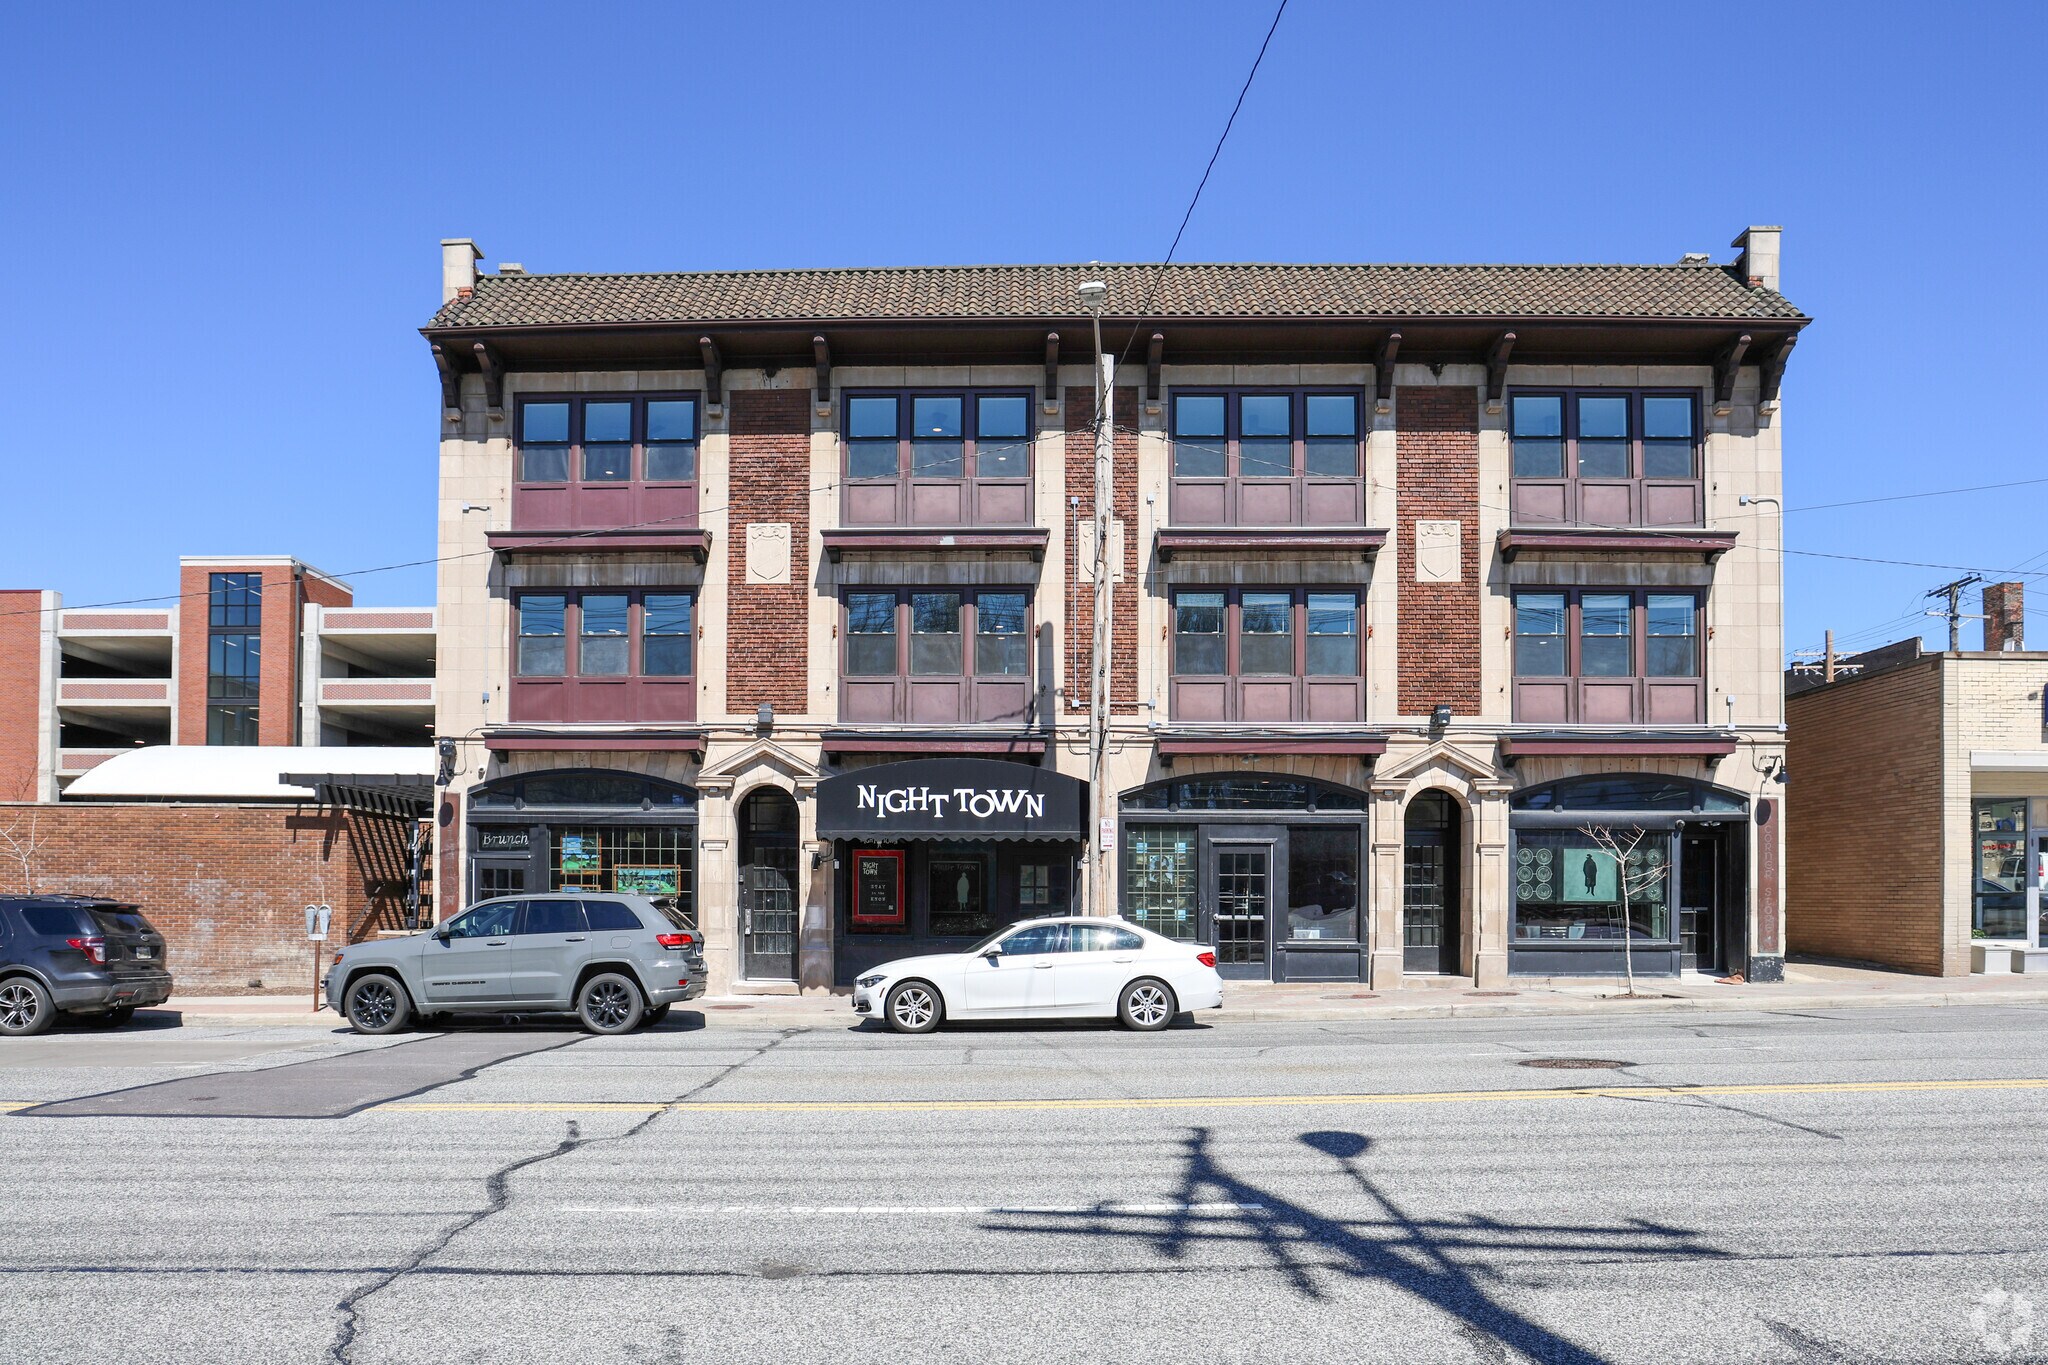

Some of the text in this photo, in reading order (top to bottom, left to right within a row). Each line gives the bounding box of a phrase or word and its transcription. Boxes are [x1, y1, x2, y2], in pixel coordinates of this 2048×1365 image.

[857, 784, 1045, 818] NIGHT TOWN
[483, 831, 529, 846] Brunch
[862, 861, 879, 870] NIGHT
[863, 868, 878, 876] TOWN
